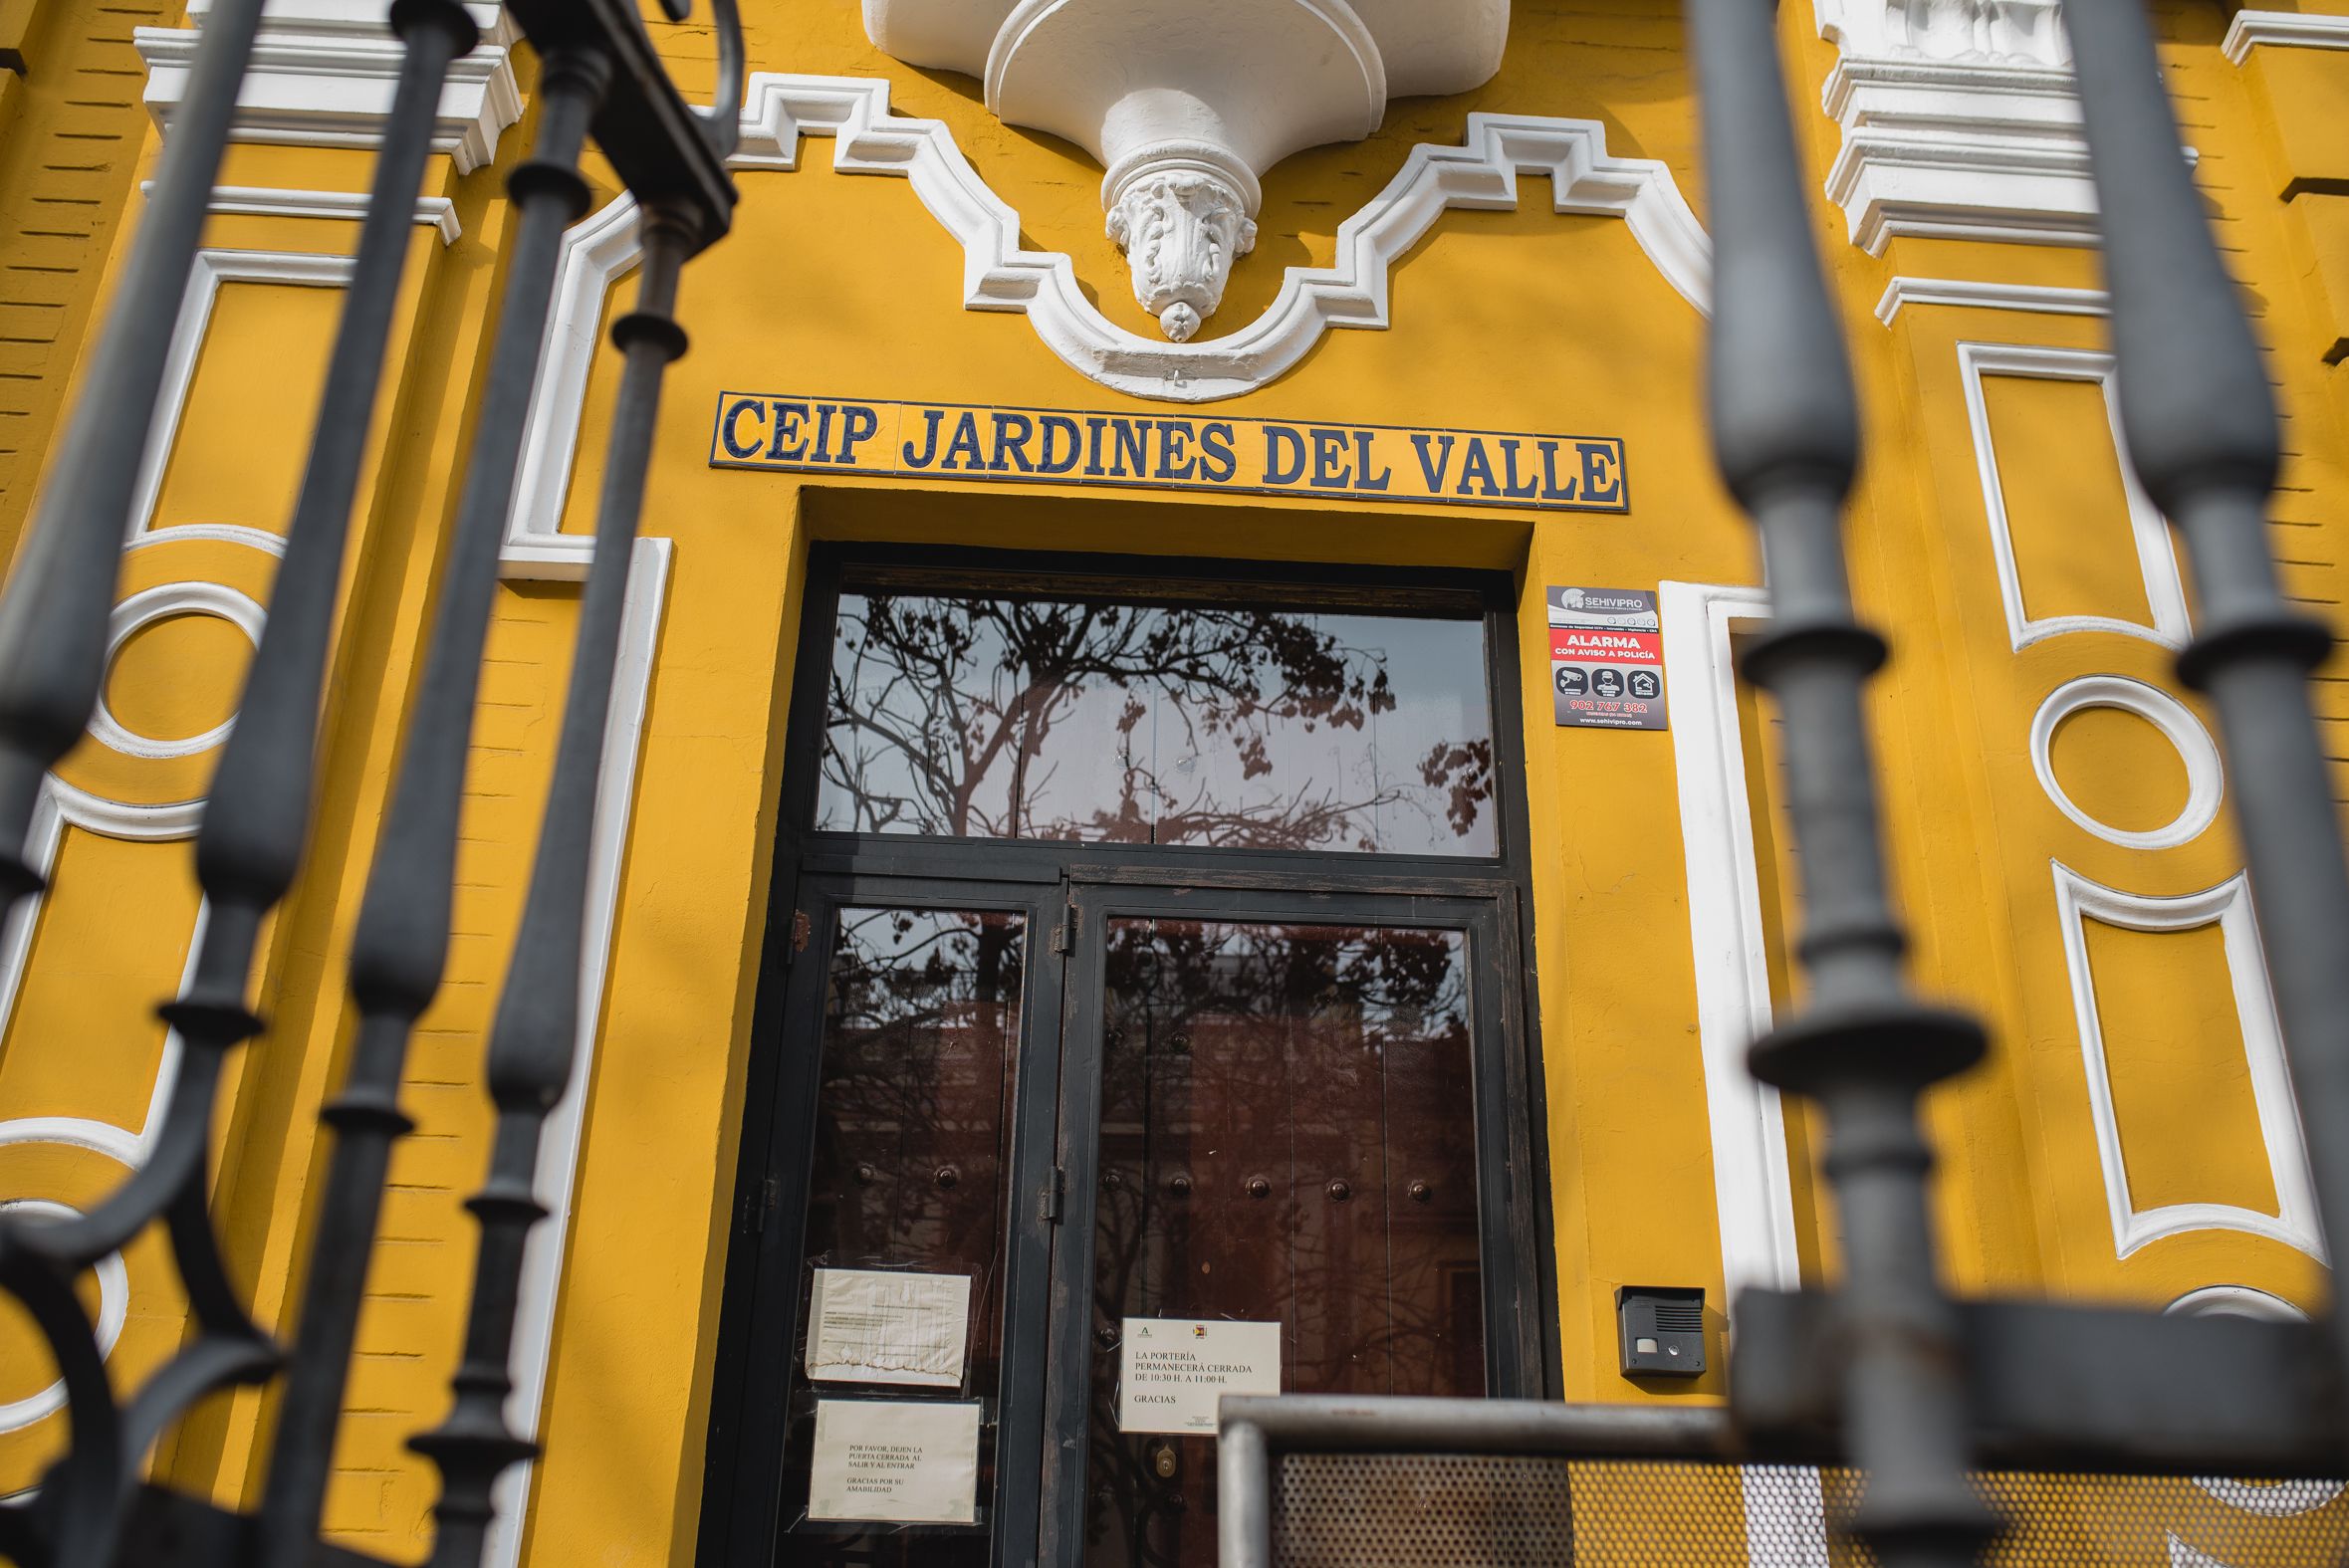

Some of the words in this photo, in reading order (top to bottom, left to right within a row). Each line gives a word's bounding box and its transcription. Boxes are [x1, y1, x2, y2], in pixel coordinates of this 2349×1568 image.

[722, 399, 878, 464] CEIP
[902, 410, 1237, 482] JARDINES
[1263, 426, 1392, 490] DEL
[1410, 434, 1620, 502] VALLE
[1585, 597, 1643, 608] SEHIVIPRO
[1567, 635, 1641, 649] ALARMA
[1617, 650, 1656, 659] POLICÍA
[1569, 700, 1593, 710] 902
[1597, 701, 1621, 711] 767
[1623, 702, 1648, 713] 382
[1150, 1351, 1196, 1361] PORTERÍA
[1135, 1362, 1205, 1372] PERMANECERÁ
[1135, 1373, 1148, 1382] DE
[1195, 1375, 1216, 1384] 11:00
[1134, 1395, 1176, 1404] GRACIAS
